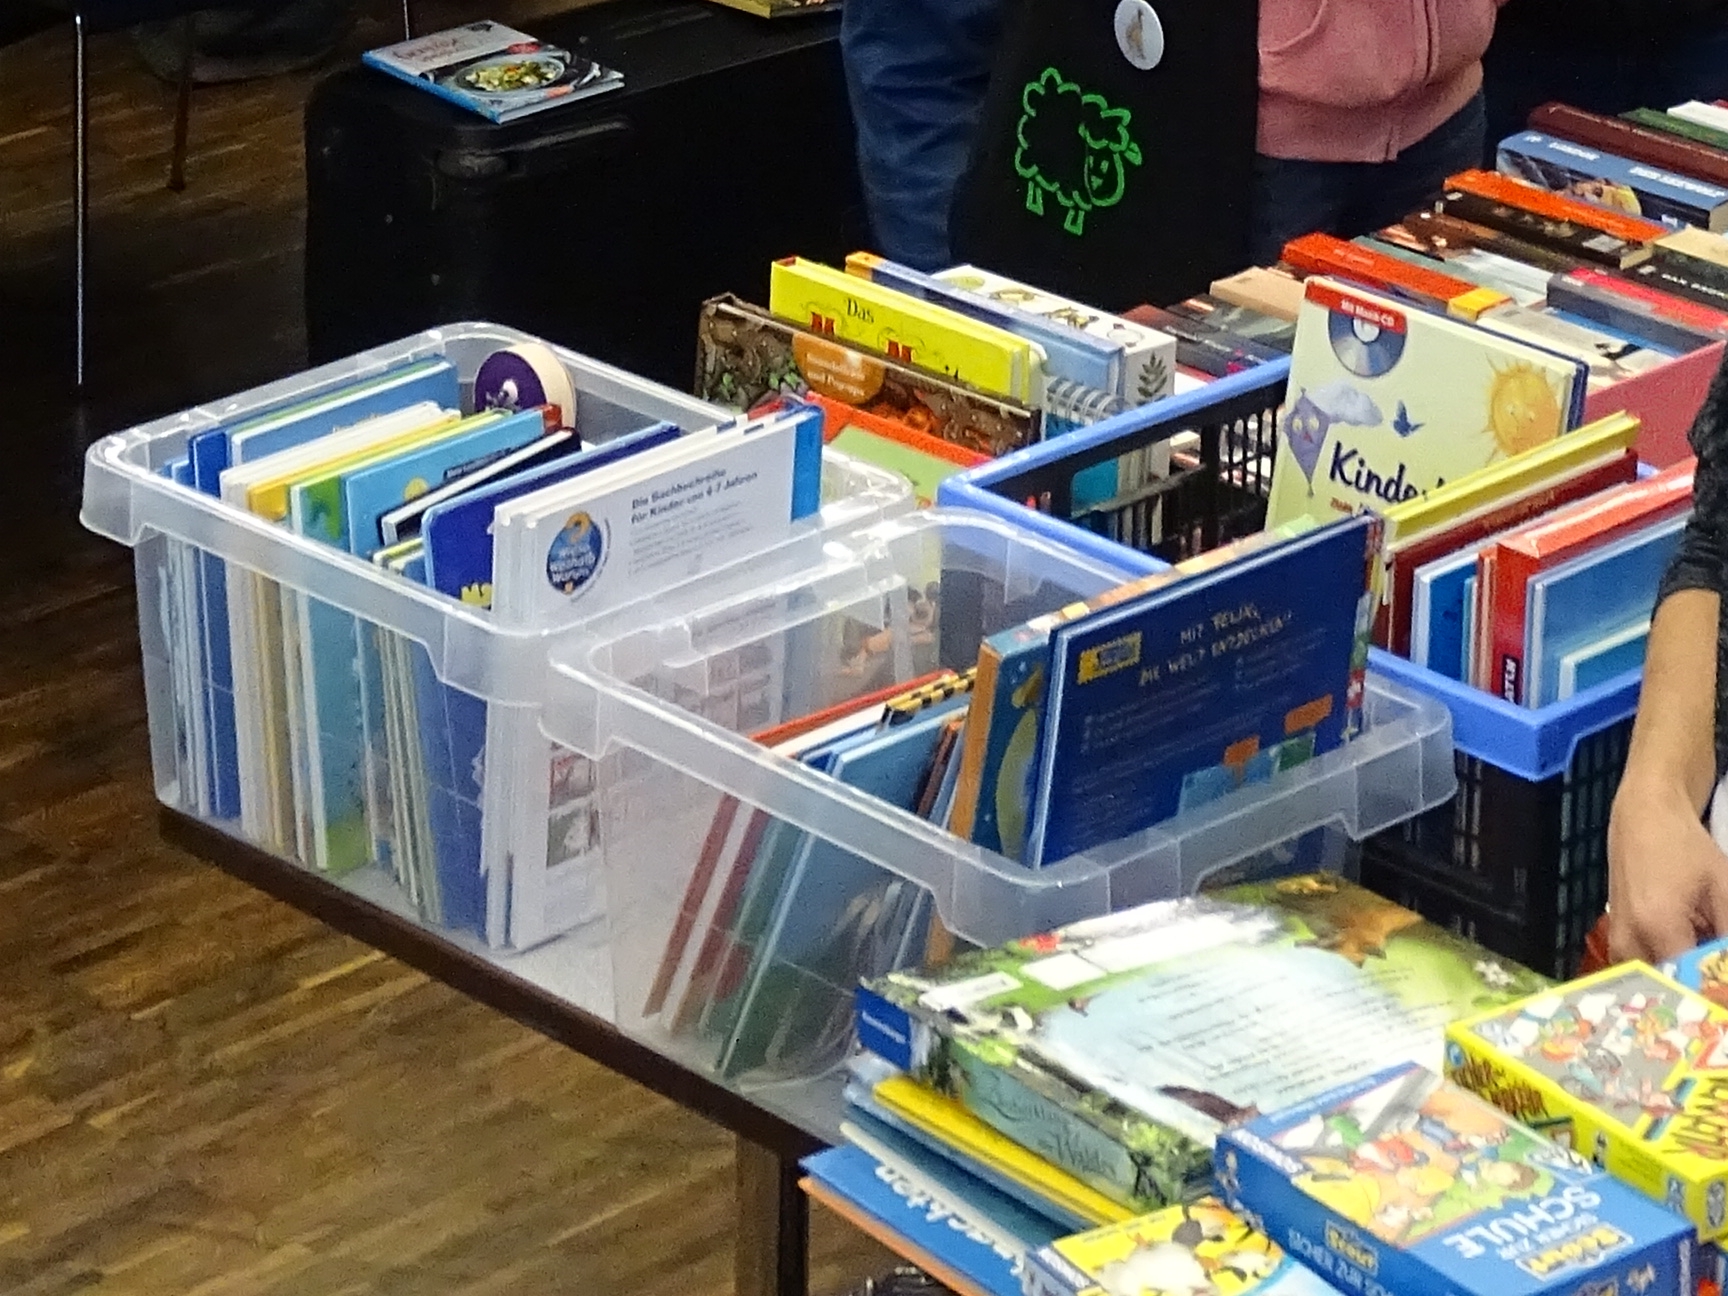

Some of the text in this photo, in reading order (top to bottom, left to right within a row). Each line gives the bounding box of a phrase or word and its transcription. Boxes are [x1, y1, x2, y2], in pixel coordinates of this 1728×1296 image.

[846, 297, 875, 325] Das
[649, 500, 685, 519] Kinder
[723, 471, 759, 492] Jahren
[1442, 1184, 1604, 1260] SCHULE
